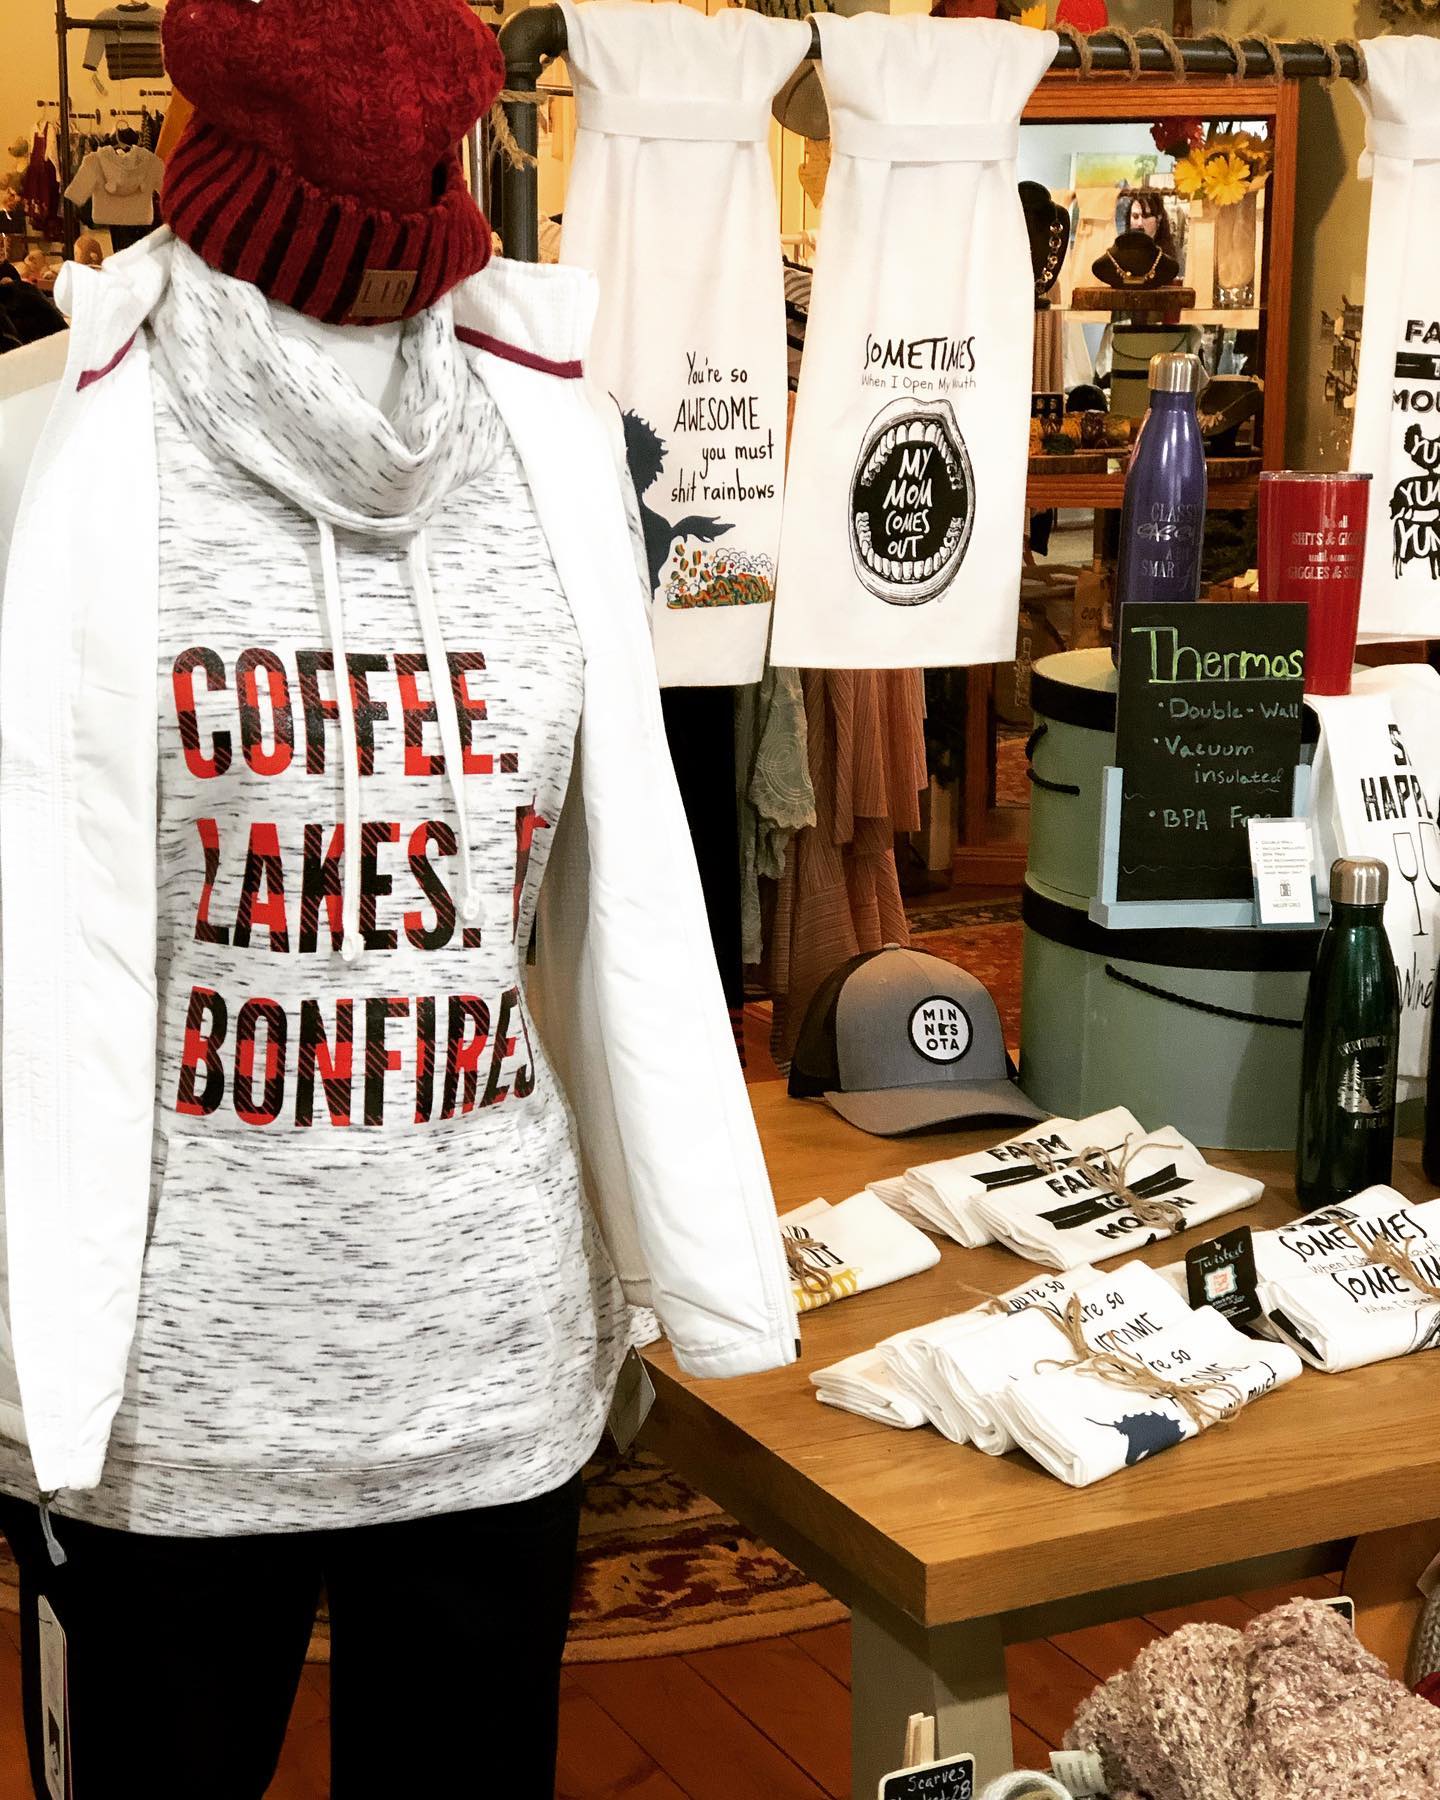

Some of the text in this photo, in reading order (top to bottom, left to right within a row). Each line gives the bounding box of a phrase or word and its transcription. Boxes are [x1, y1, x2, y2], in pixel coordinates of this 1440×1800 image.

[864, 333, 976, 372] SOMETIMES
[687, 351, 748, 385] You're so
[892, 375, 898, 388] I
[903, 376, 933, 393] Open
[673, 396, 760, 432] AWESOME
[700, 428, 774, 480] you must
[898, 447, 933, 480] MY
[671, 468, 775, 502] shit rainbows
[882, 478, 933, 509] MOM
[886, 509, 930, 535] COMES
[887, 535, 924, 559] OUT
[1292, 532, 1324, 546] SHITS
[171, 647, 518, 779] COFFEE.
[1165, 735, 1254, 757] Vacuum
[1194, 762, 1283, 784] insulated
[1163, 808, 1208, 830] BPA
[194, 816, 482, 954] LAKES.
[923, 1008, 957, 1021] MIN
[926, 1038, 959, 1051] OTA
[986, 1134, 1072, 1161] FAM
[1045, 1280, 1065, 1294] so
[1106, 1291, 1124, 1310] so
[1171, 1350, 1192, 1364] so
[907, 1766, 966, 1792] Scarves
